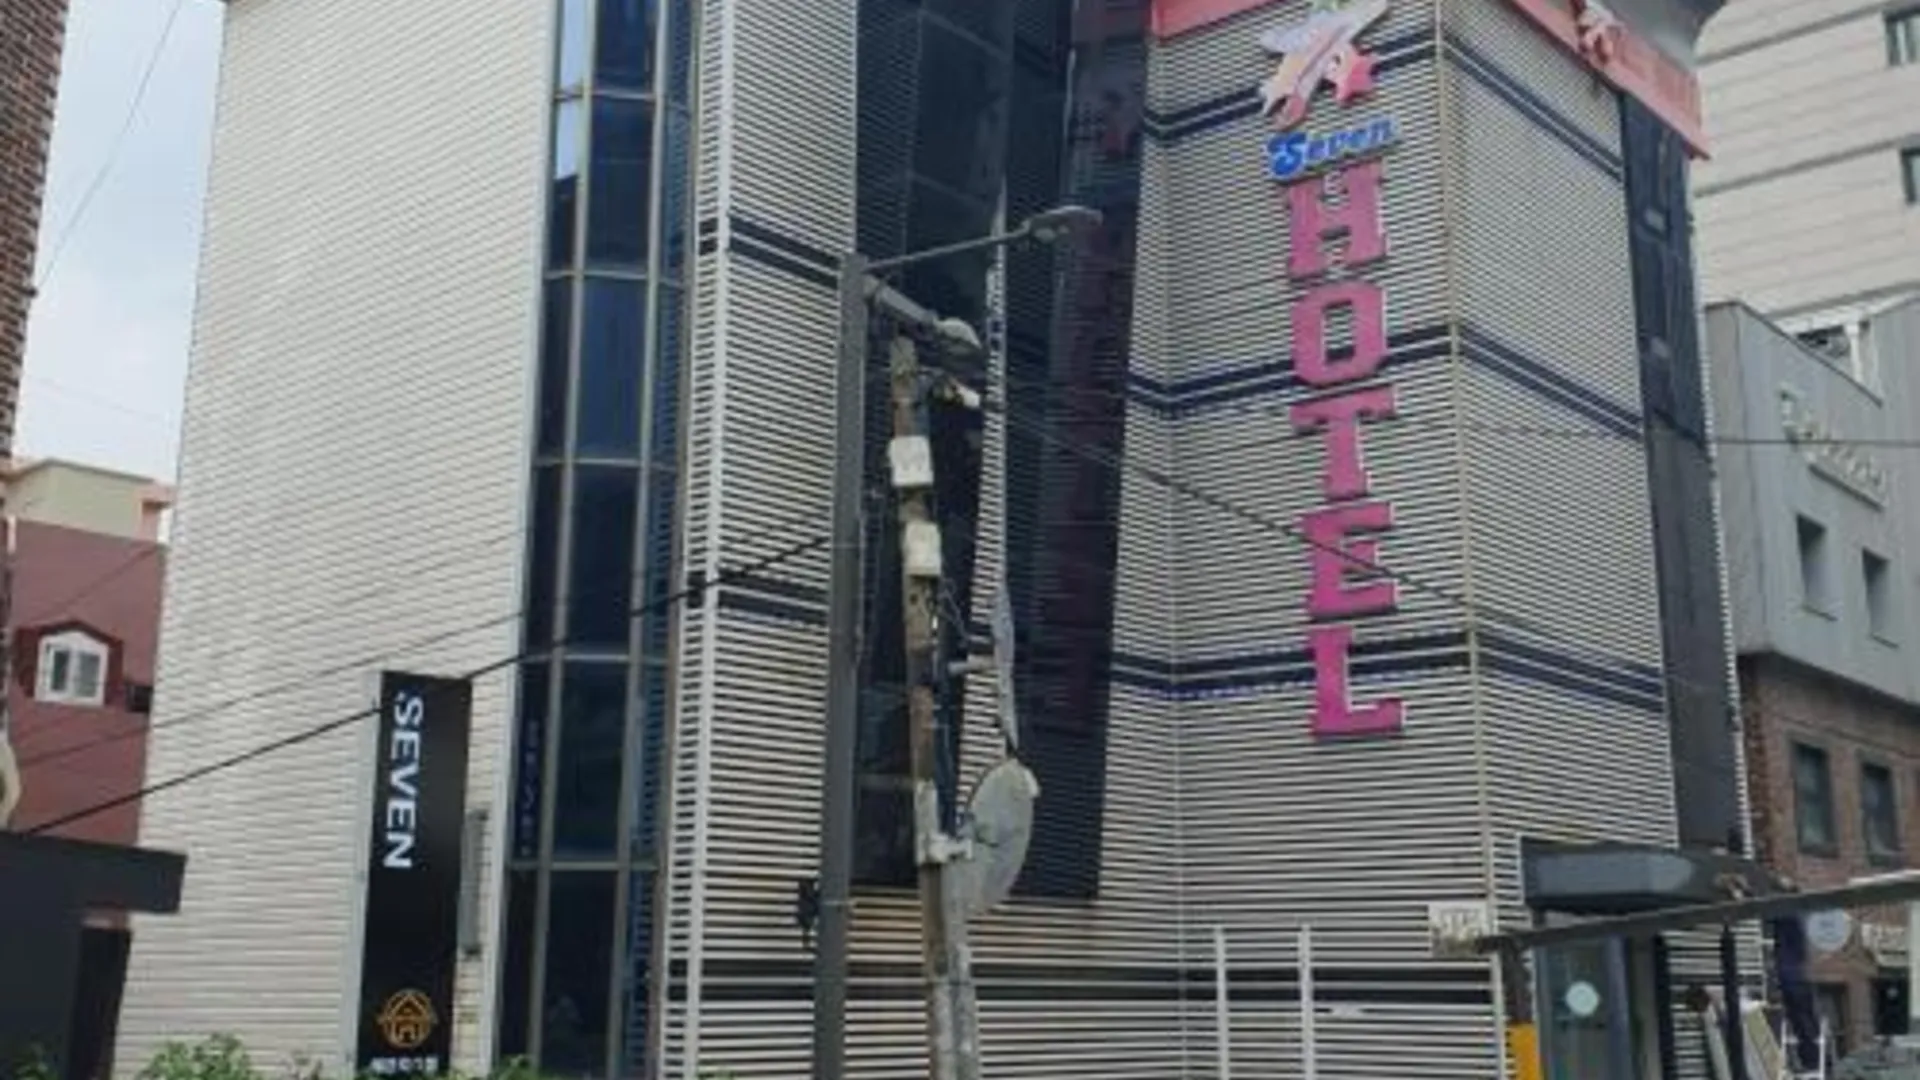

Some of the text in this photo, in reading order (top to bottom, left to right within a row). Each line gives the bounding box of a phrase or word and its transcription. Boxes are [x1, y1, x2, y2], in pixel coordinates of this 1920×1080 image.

[1266, 115, 1400, 181] Seven
[1287, 157, 1403, 738] HOTEL
[383, 691, 424, 868] SEVEN
